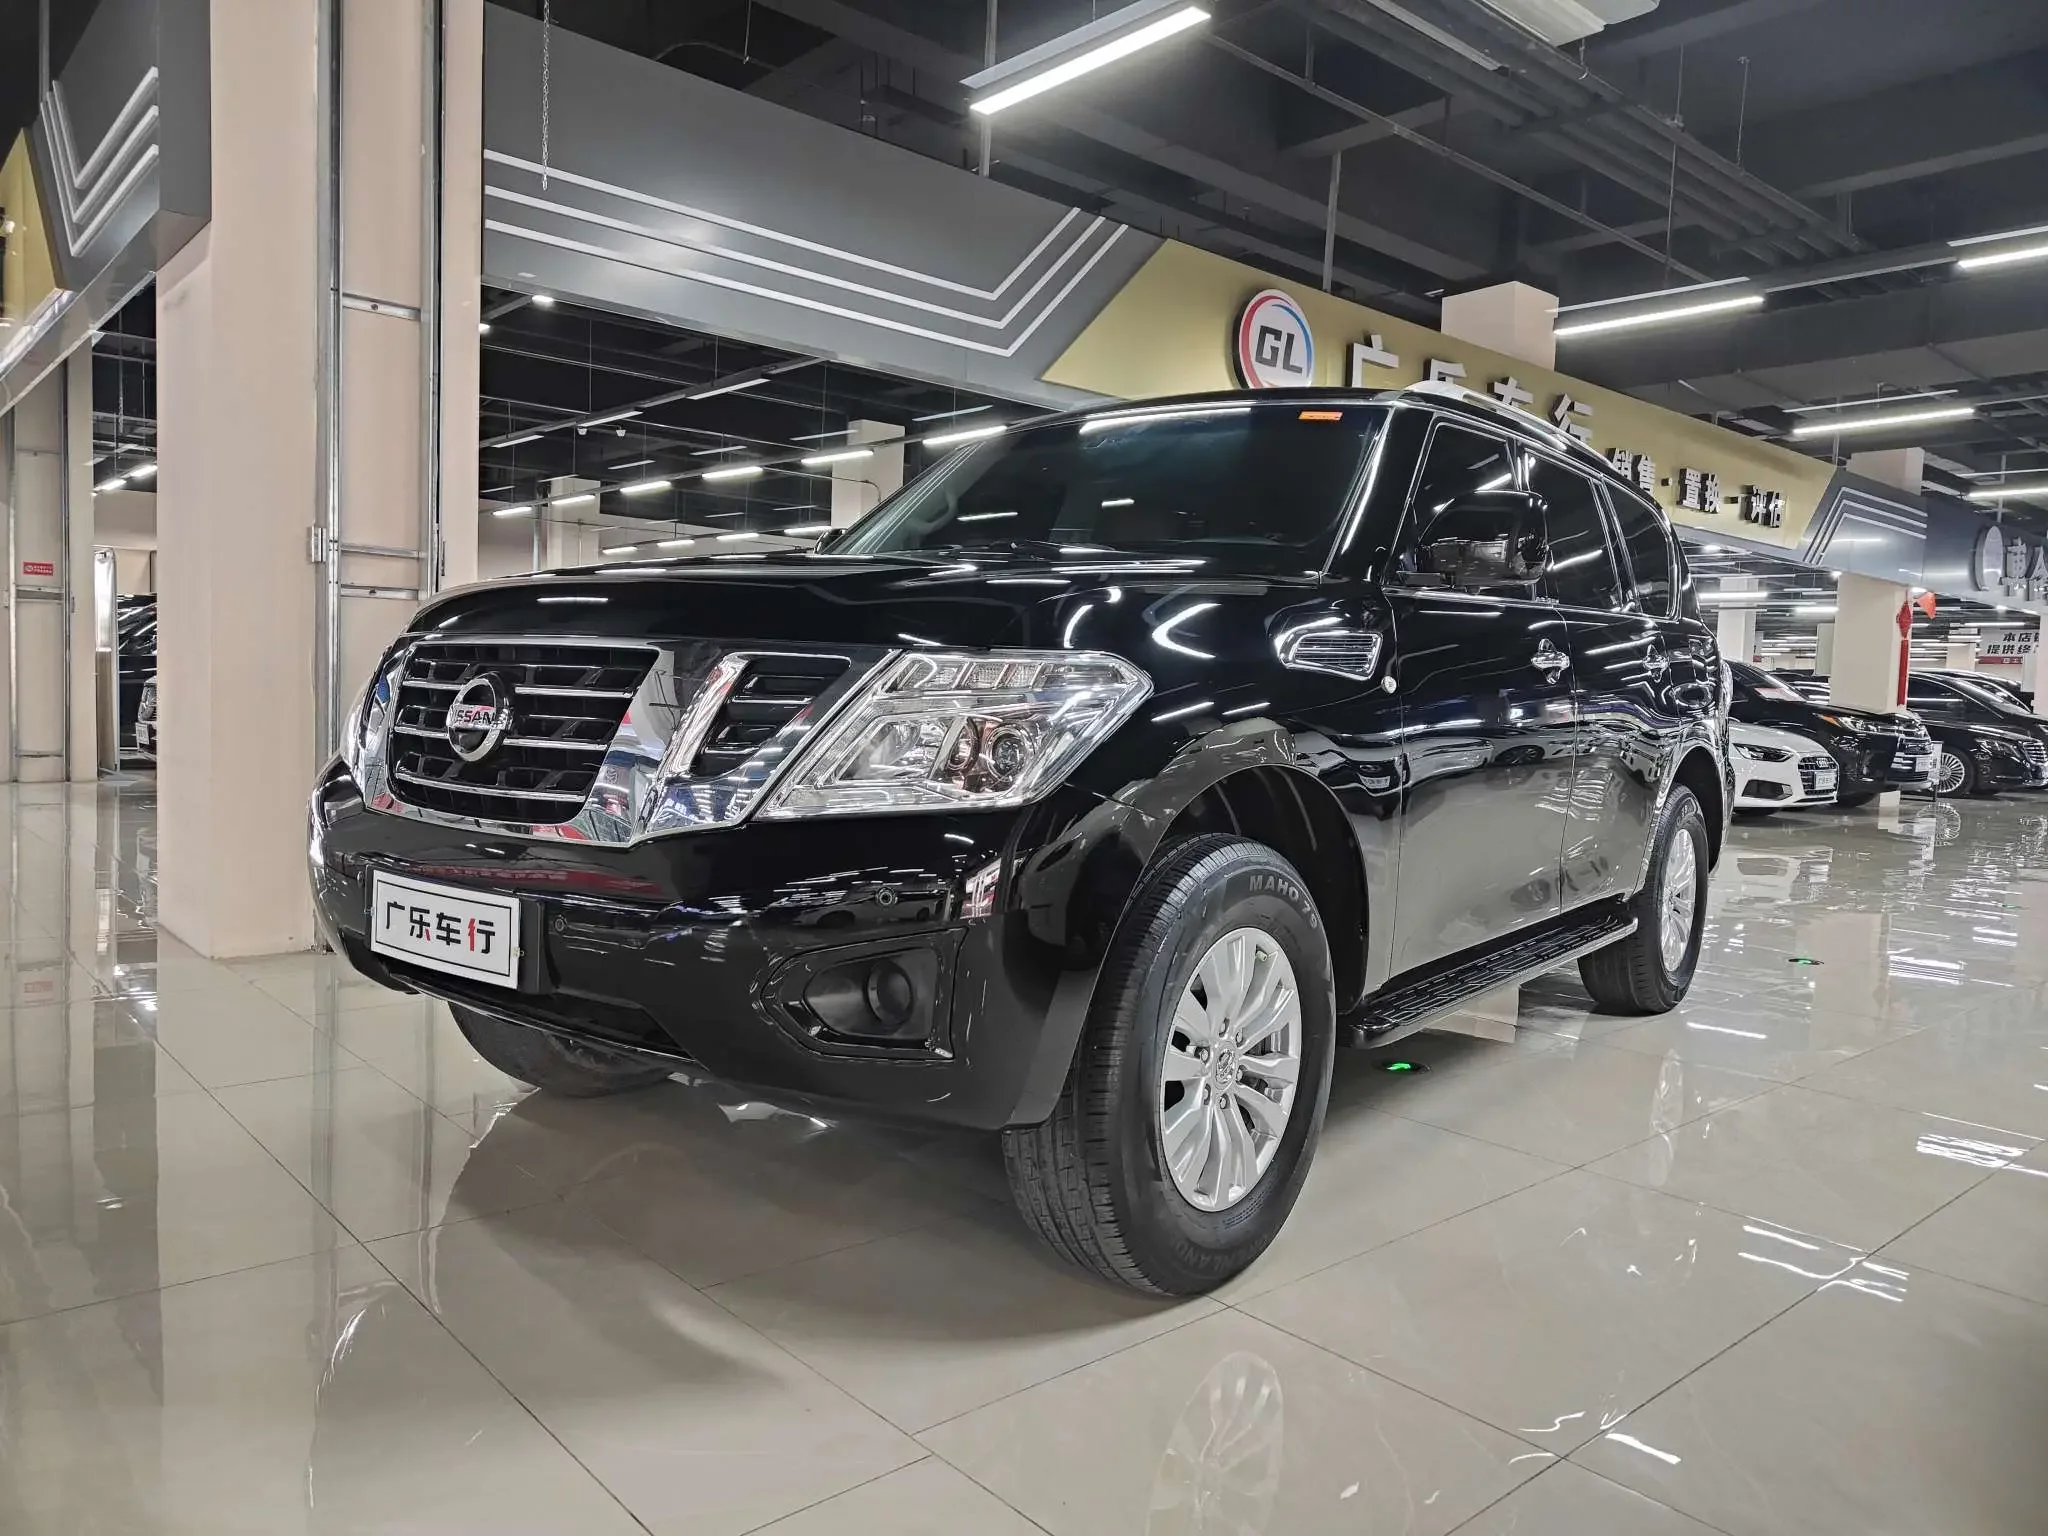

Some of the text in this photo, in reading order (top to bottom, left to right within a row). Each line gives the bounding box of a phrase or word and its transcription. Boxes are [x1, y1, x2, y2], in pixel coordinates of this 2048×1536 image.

[1255, 325, 1303, 374] GL
[452, 708, 497, 725] SSAN
[386, 900, 496, 955] 广乐车行
